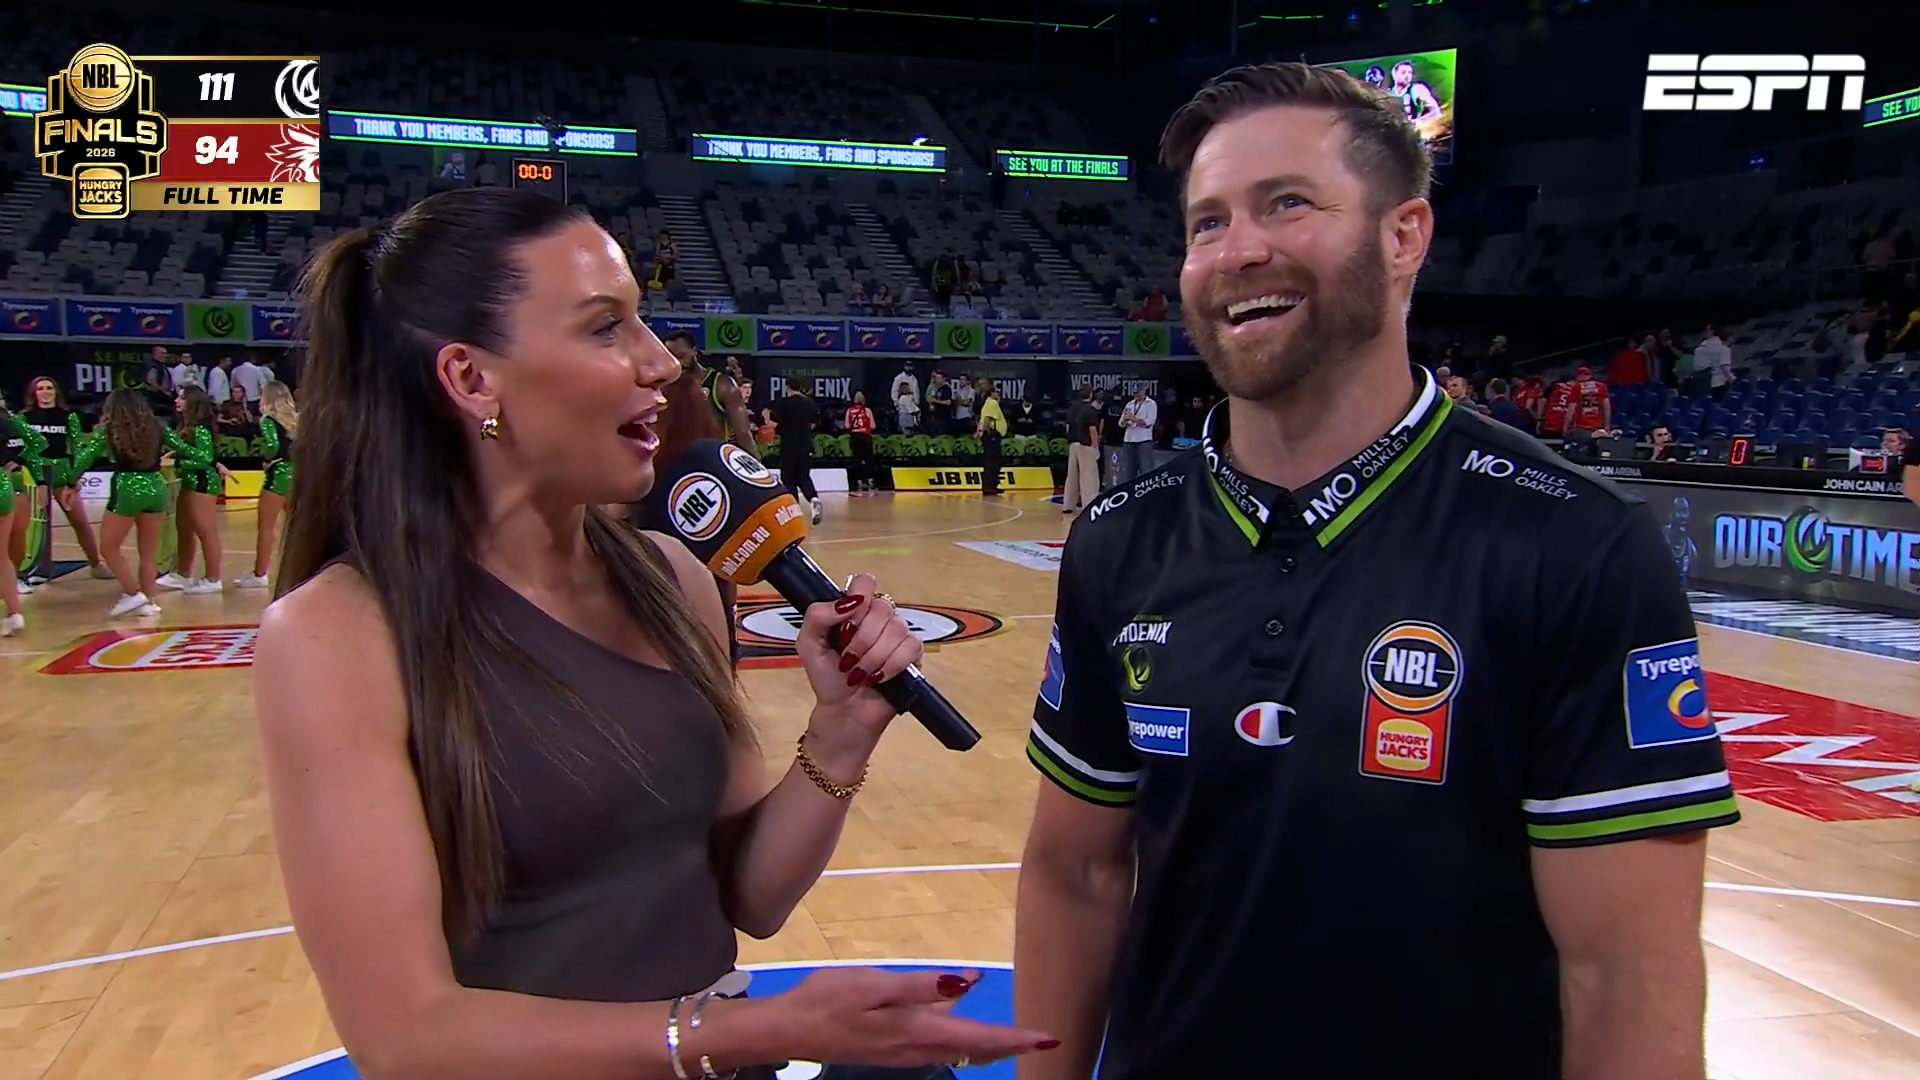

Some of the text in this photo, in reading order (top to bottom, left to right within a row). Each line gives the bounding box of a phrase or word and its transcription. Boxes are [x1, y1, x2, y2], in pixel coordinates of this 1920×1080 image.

[1882, 100, 1903, 118] SEE
[354, 118, 397, 137] THANK
[399, 121, 425, 139] YOU
[426, 123, 489, 143] MEMBERS,
[491, 127, 523, 144] FANS
[524, 129, 549, 146] AND
[706, 140, 935, 168] THANK YOU MEMBERS, FANS AND SPONSORS!
[1008, 157, 1119, 175] SEE YOU AT THE FINALS
[1352, 436, 1391, 469] MILLS
[1362, 432, 1409, 478] OAKLEY
[1461, 450, 1515, 477] MO
[1731, 439, 1748, 466] 0
[928, 472, 962, 485] JB
[1134, 471, 1169, 491] MILLS
[1134, 475, 1185, 498] OAKLEY
[1220, 466, 1249, 495] MILLS
[1514, 476, 1578, 500] OAKLEY
[1521, 468, 1567, 487] MILLS
[1823, 478, 1856, 491] JOHN
[1855, 480, 1885, 492] CAIN
[678, 488, 717, 528] NBL
[1091, 491, 1129, 521] MO
[1219, 477, 1256, 514] OAKLEY
[1310, 472, 1357, 520] MO
[721, 525, 771, 576] nbl.com.au
[1714, 516, 1920, 596] OUR TIME
[1384, 647, 1438, 688] NBL
[1380, 731, 1429, 747] HUNGRY
